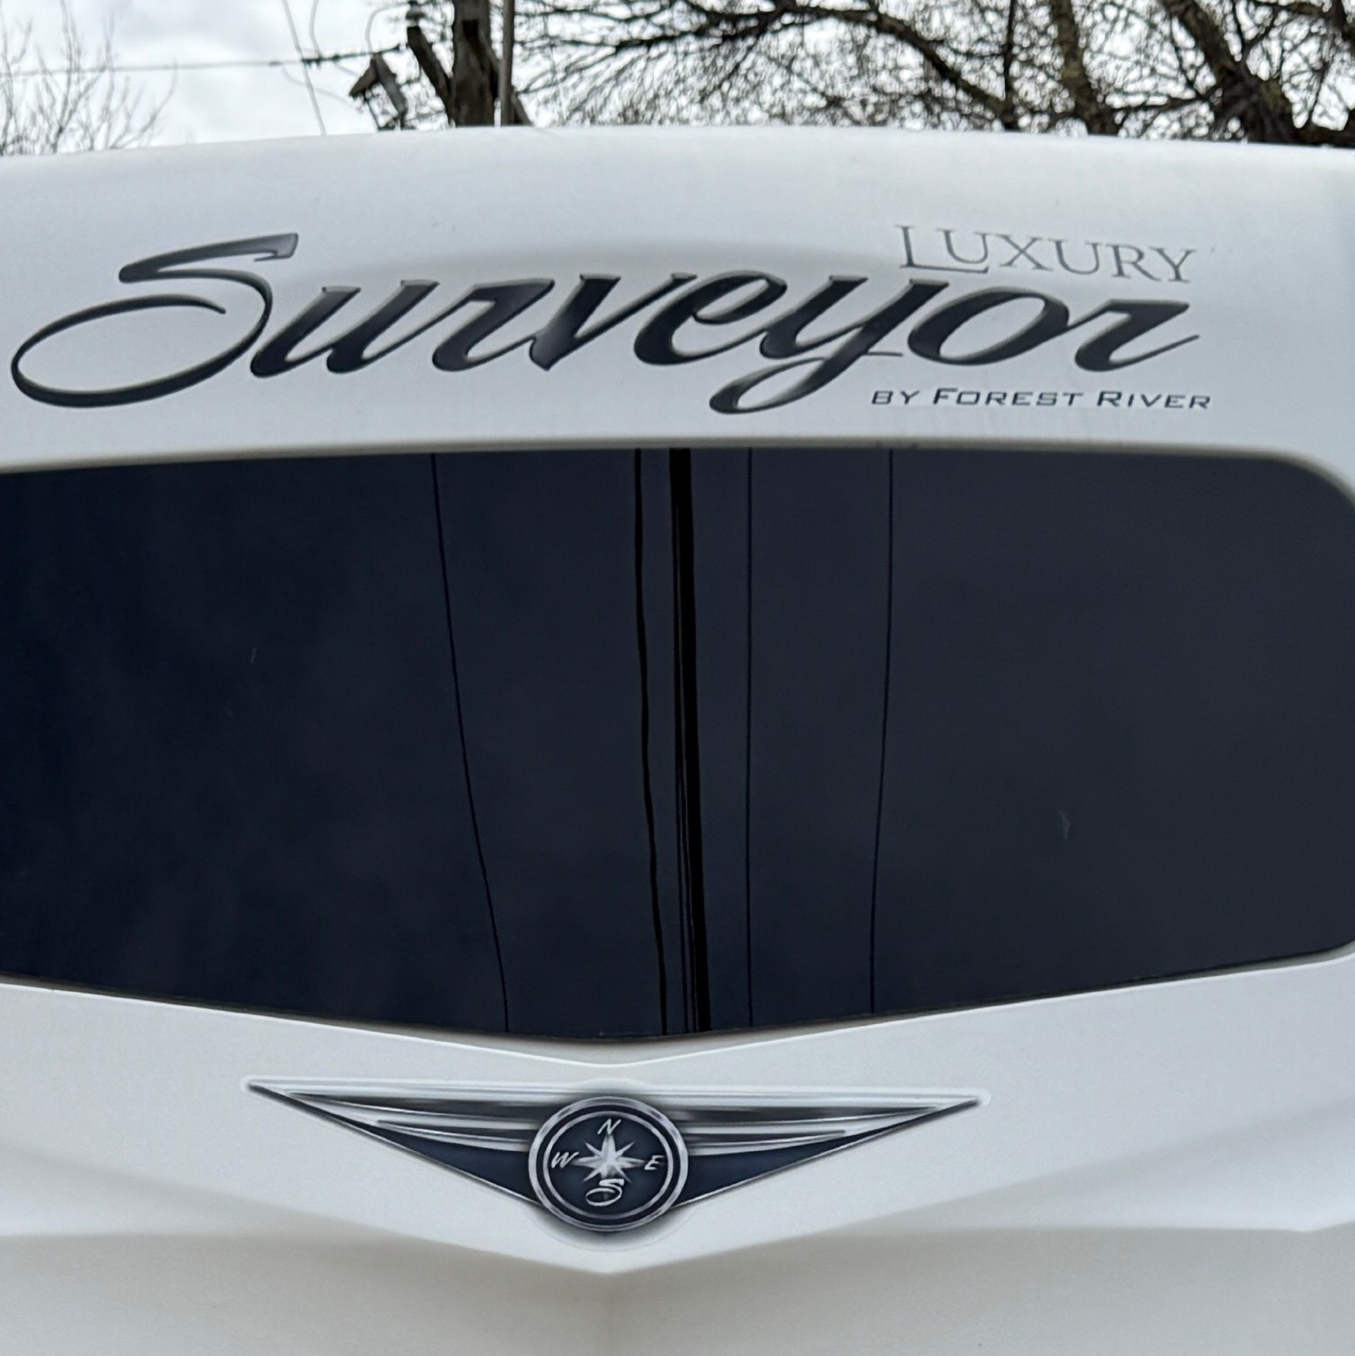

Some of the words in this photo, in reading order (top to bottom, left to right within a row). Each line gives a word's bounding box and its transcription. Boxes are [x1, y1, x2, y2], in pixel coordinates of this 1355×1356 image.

[894, 223, 1196, 283] LUXURY
[10, 232, 1200, 414] Surveyor
[870, 389, 920, 407] BY
[932, 387, 1084, 407] FOREST
[1096, 390, 1211, 410] RIVER
[596, 1117, 622, 1136] N
[550, 1151, 579, 1169] W
[643, 1154, 665, 1171] E
[585, 1178, 625, 1207] S
